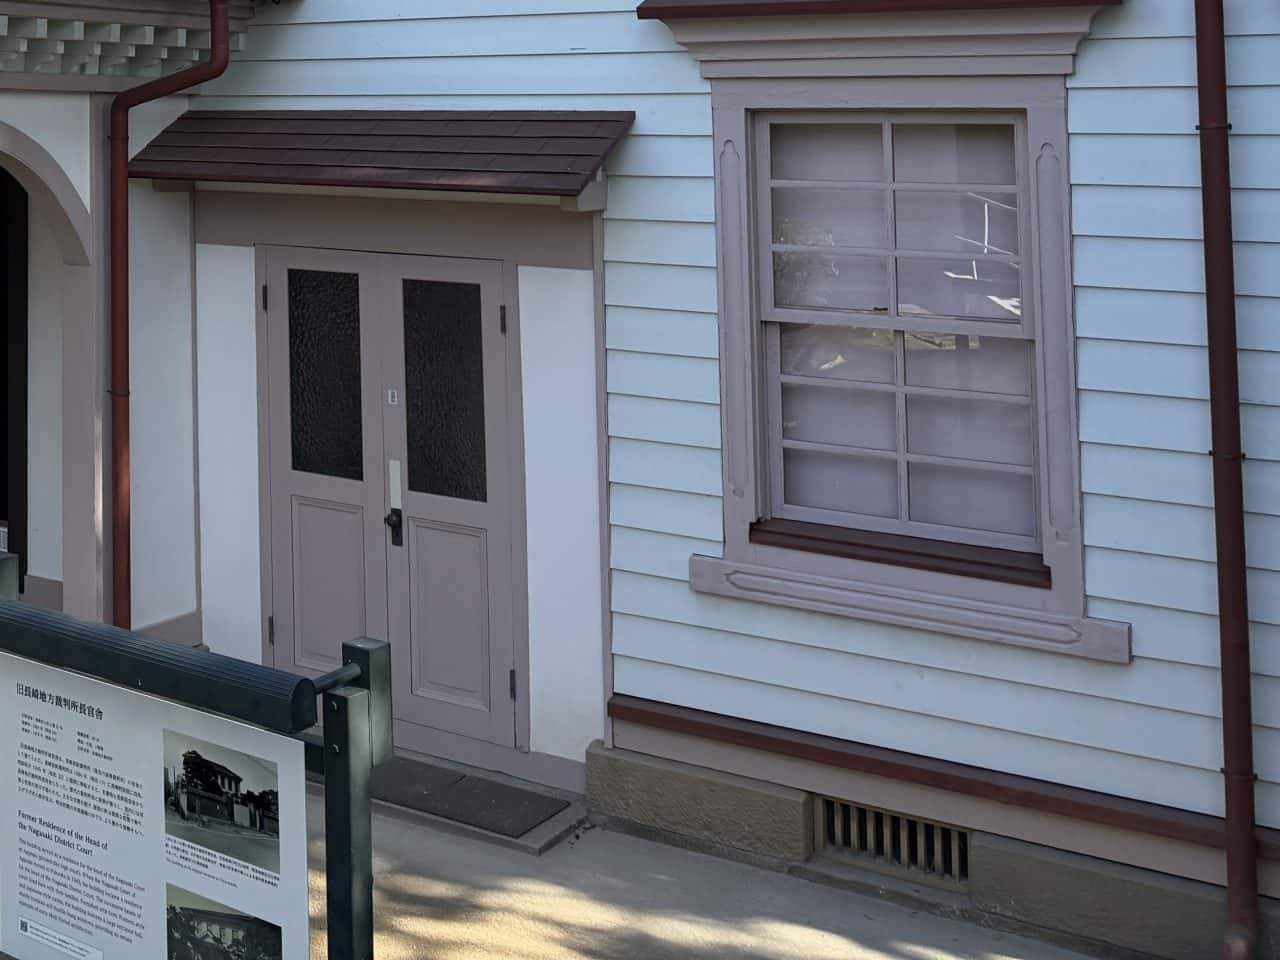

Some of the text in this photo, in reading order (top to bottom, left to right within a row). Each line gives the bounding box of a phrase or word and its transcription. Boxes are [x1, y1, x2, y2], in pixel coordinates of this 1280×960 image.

[17, 809, 37, 824] Former
[38, 817, 66, 835] Residence
[74, 830, 84, 842] the
[85, 834, 101, 848] Head
[101, 840, 108, 851] of
[28, 825, 53, 841] Nagasaki
[54, 834, 75, 850] District
[76, 844, 93, 857] Court
